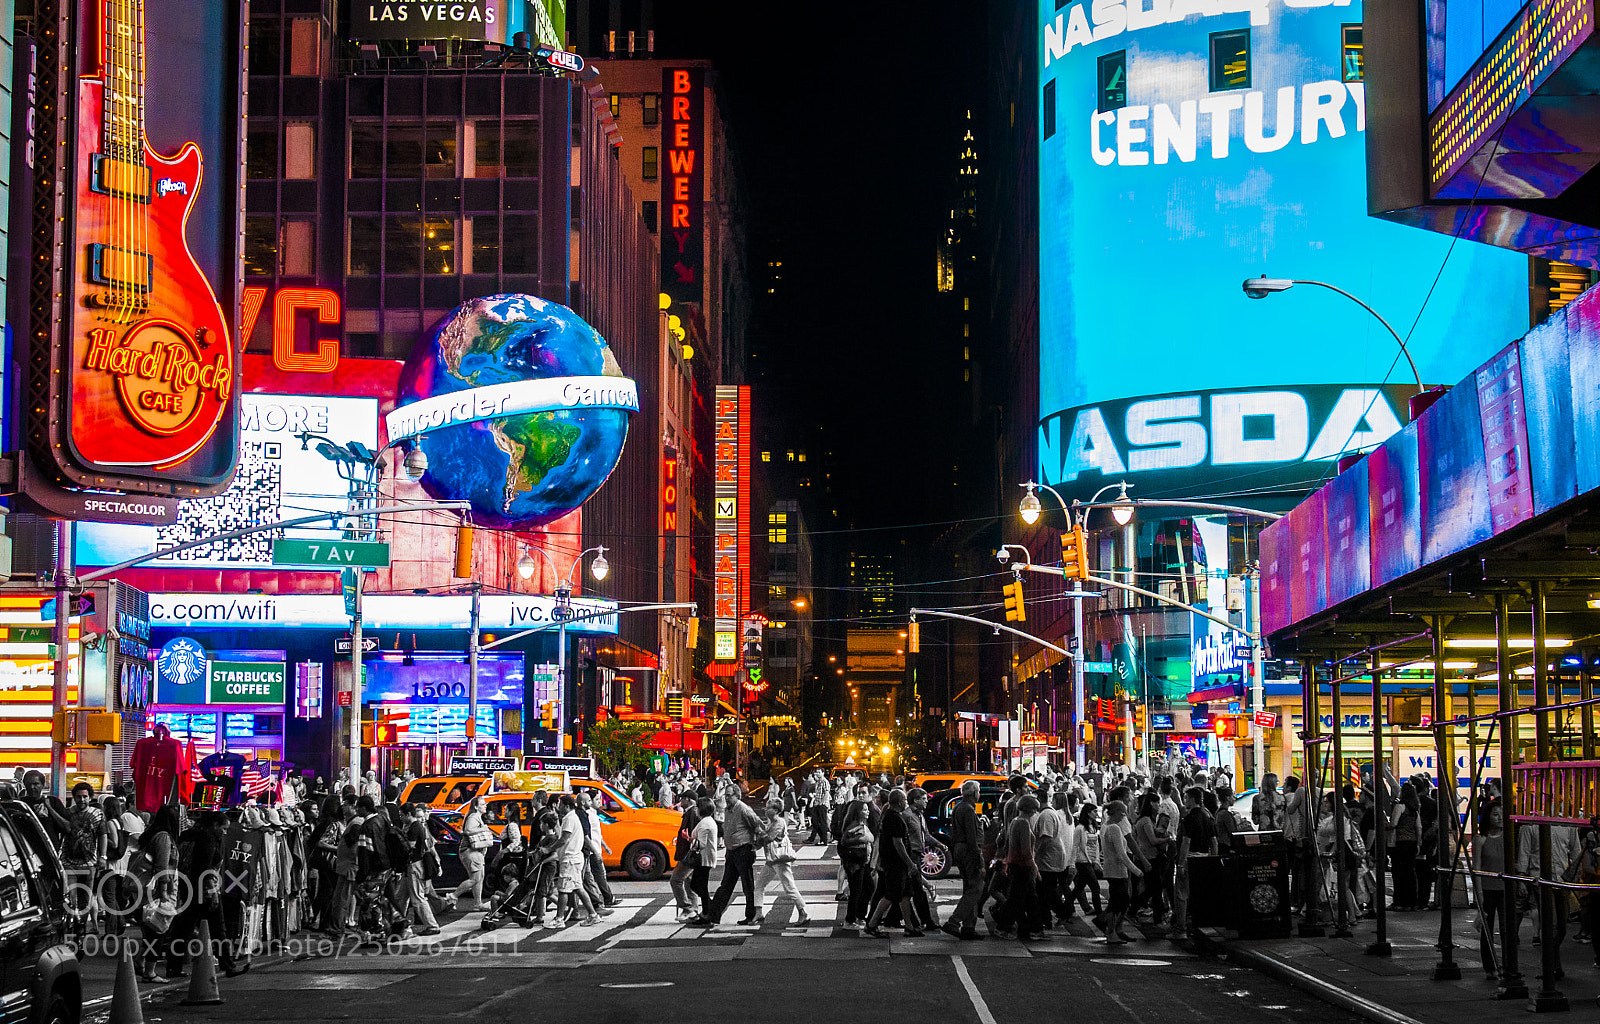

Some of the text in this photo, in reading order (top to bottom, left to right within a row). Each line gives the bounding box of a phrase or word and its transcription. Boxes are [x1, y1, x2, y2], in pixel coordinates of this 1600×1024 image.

[369, 5, 496, 24] LAS VEGAS
[551, 51, 578, 70] FUEL
[669, 70, 696, 254] BREWERY
[85, 328, 231, 400] Hard Rock
[140, 391, 183, 414] CAFE
[716, 400, 735, 482] PARK
[84, 499, 166, 517] SPECTACOLOR
[308, 545, 356, 561] 7 Av
[716, 533, 735, 617] PARK
[18, 629, 27, 641] 7
[213, 670, 283, 683] STARBUCKS
[226, 683, 271, 696] COFFEE
[411, 682, 466, 698] 1500
[452, 762, 514, 771] BOURNE LEGACY
[234, 840, 241, 850] I
[229, 849, 252, 863] NY
